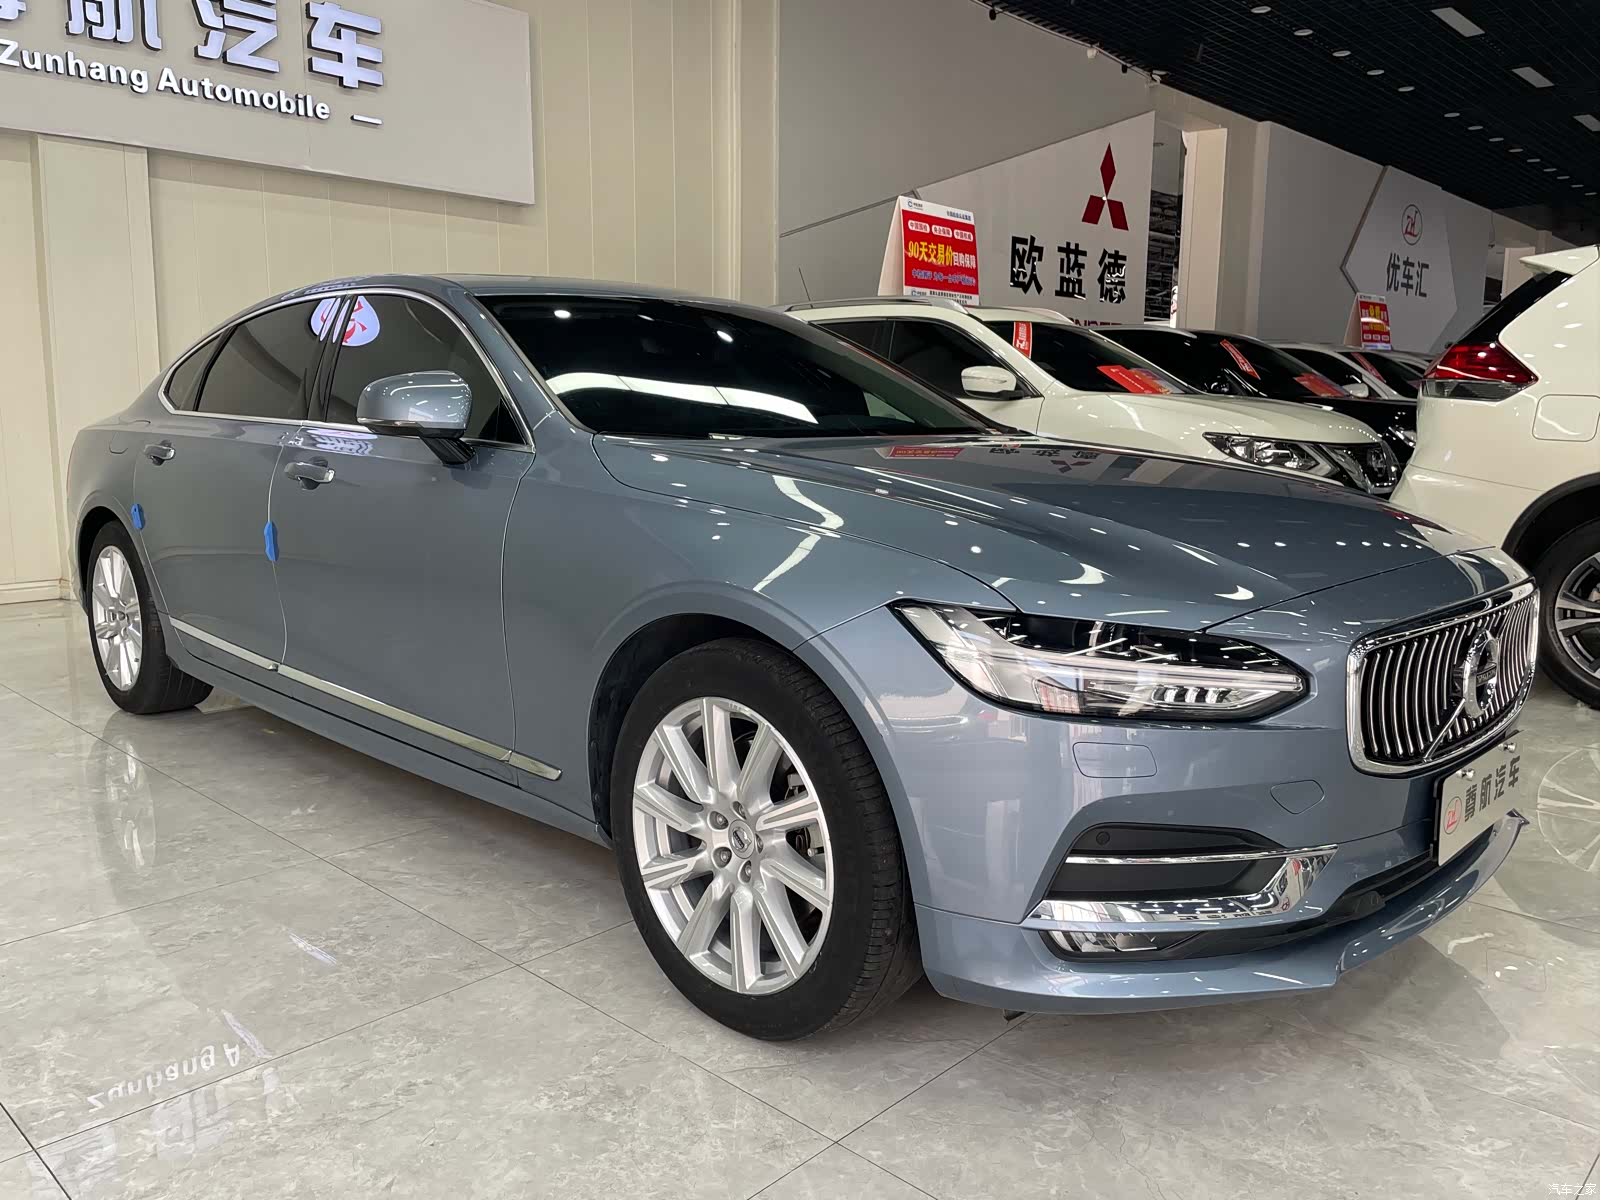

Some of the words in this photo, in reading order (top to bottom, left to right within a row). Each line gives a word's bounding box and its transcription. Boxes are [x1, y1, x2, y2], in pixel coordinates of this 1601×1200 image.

[0, 38, 149, 94] Zunhang
[156, 67, 330, 121] Automobile
[1009, 234, 1128, 304] 欧蓝德
[1386, 252, 1430, 298] 优车汇
